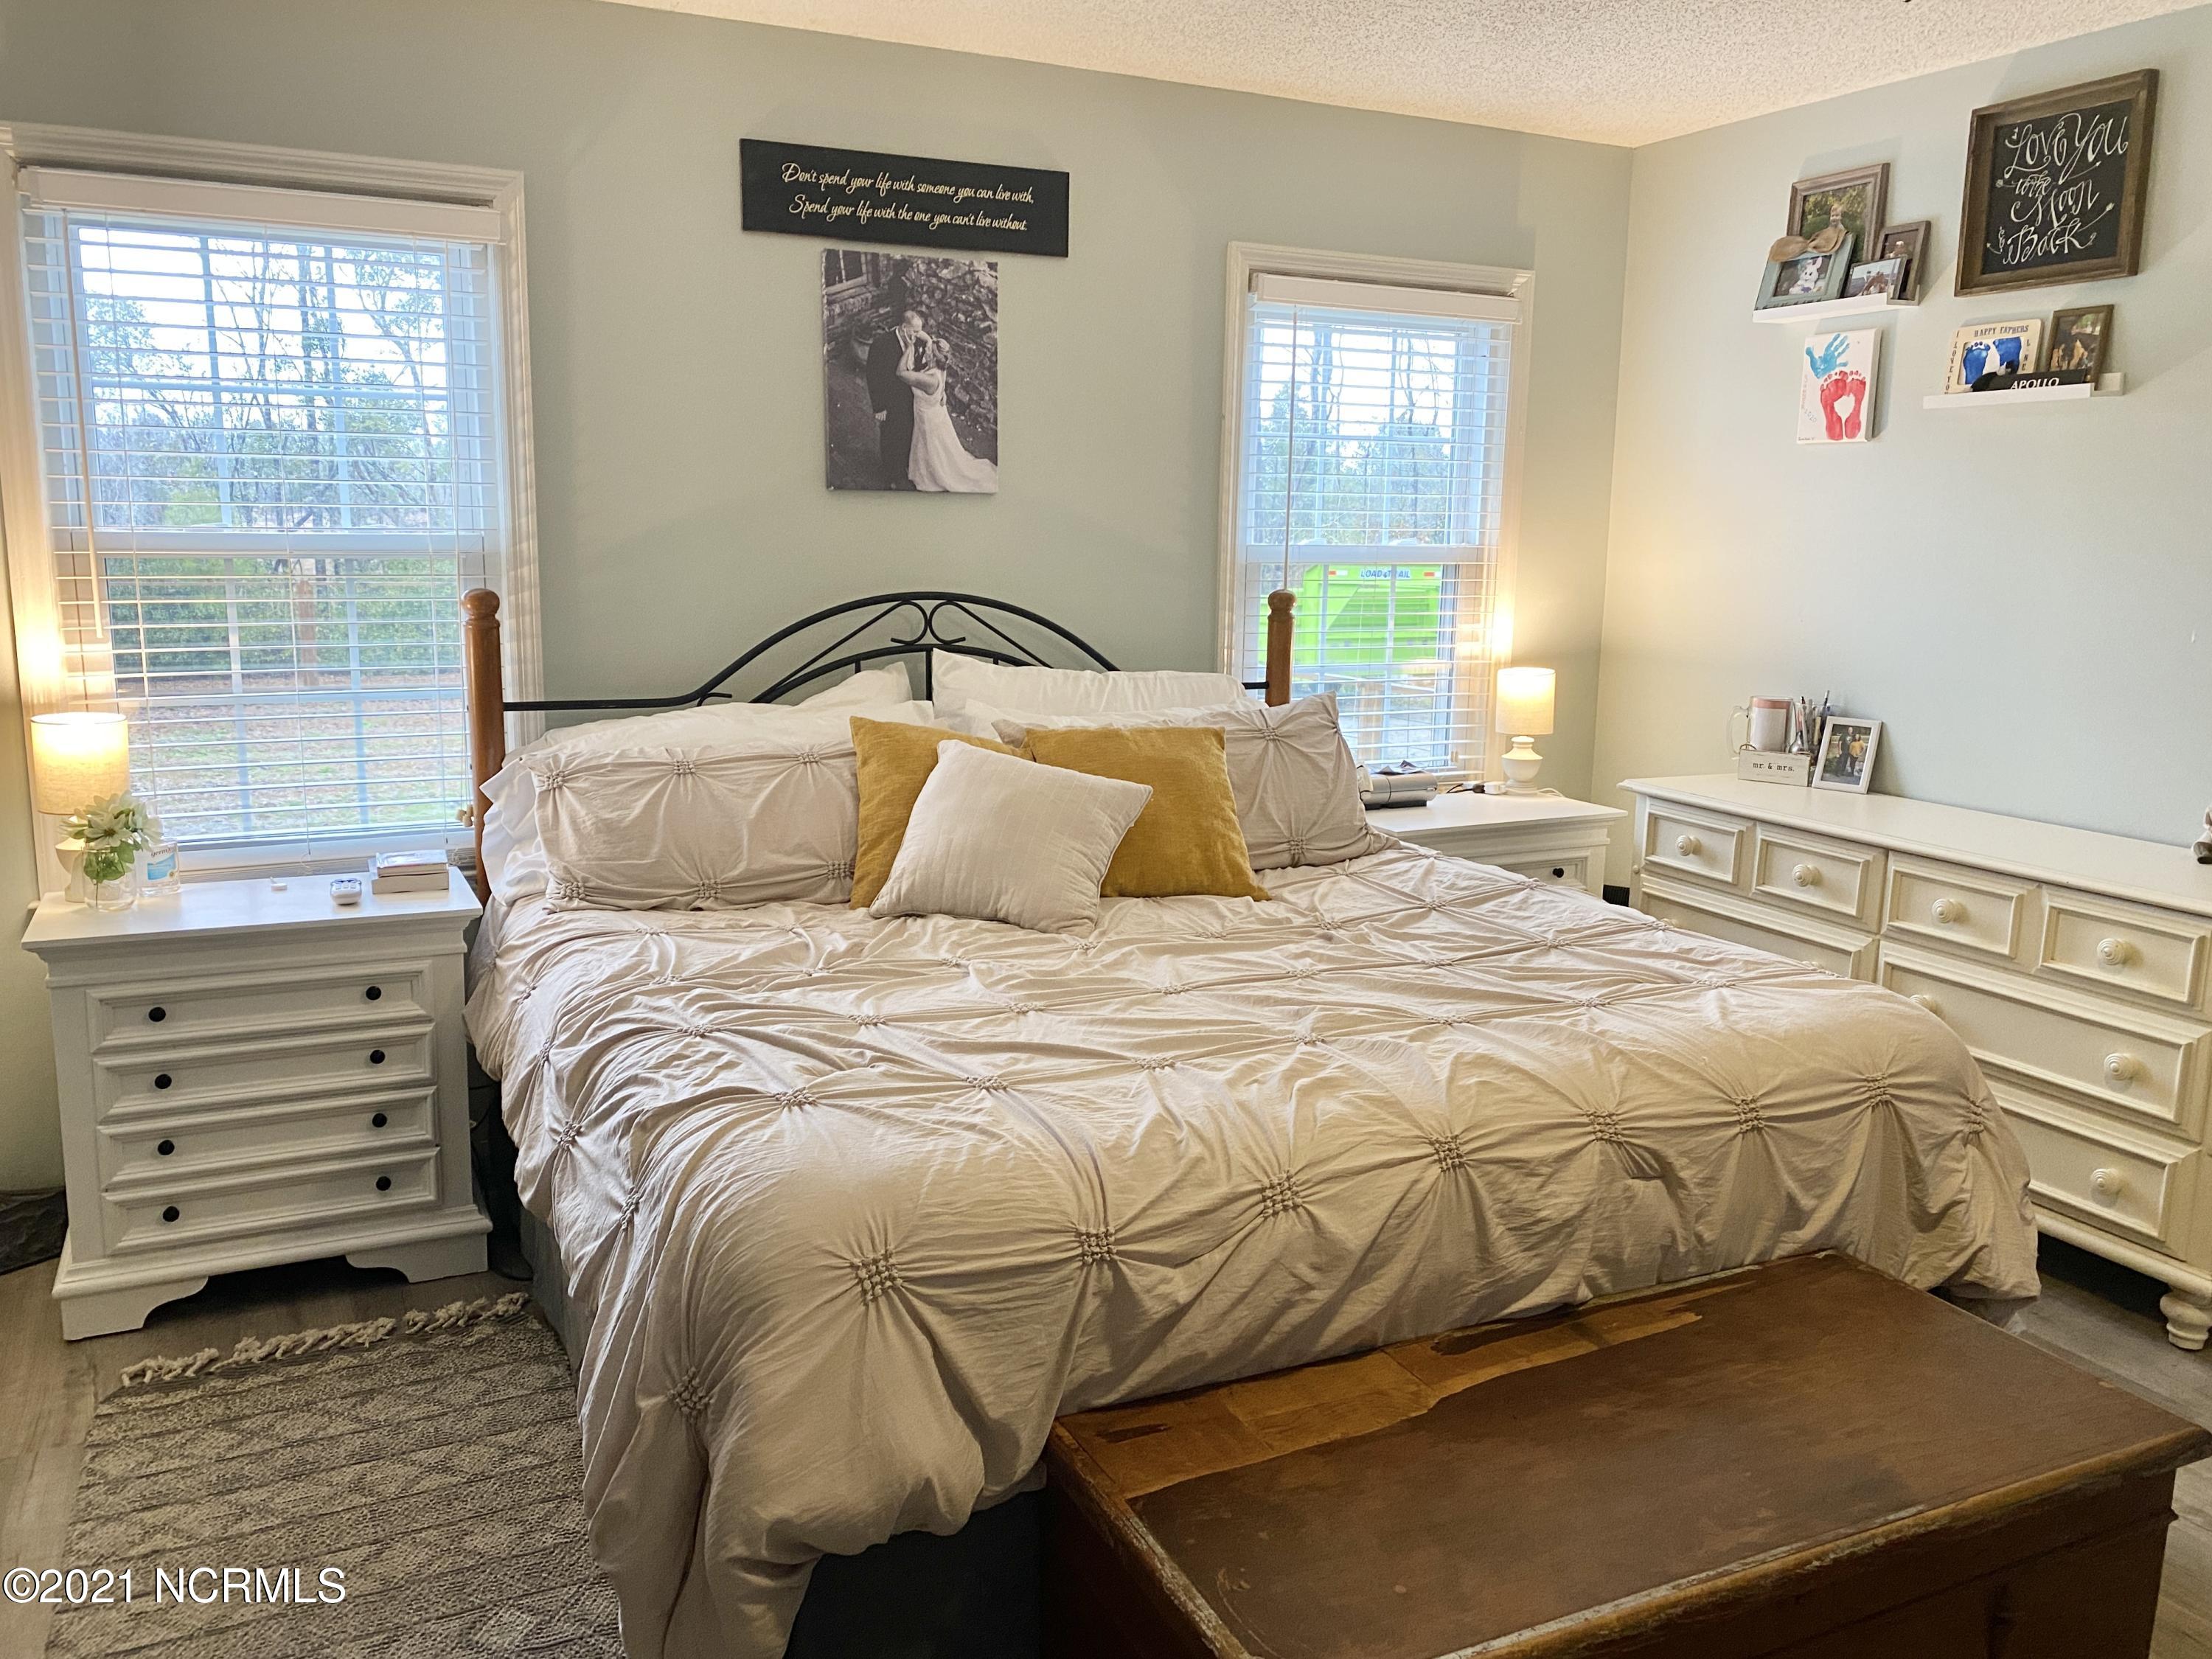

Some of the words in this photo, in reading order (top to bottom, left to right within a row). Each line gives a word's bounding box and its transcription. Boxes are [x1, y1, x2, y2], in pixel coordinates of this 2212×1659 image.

[782, 162, 817, 183] Don't
[818, 169, 851, 192] spend
[845, 175, 874, 195] your
[875, 171, 891, 197] life
[893, 175, 915, 192] with
[917, 182, 956, 195] someone
[953, 187, 975, 204] you
[976, 189, 994, 199] can
[995, 184, 1012, 201] live
[789, 193, 831, 220] Spend
[826, 204, 855, 223] your
[856, 200, 872, 225] life
[874, 203, 897, 219] with
[897, 204, 913, 220] the
[914, 211, 931, 222] one
[929, 214, 951, 230] you
[952, 212, 975, 226] can't
[976, 210, 991, 228] live
[992, 213, 1028, 231] without.
[1974, 327, 1997, 338] HAPPY
[2011, 377, 2060, 390] APOLLO
[1360, 569, 1383, 577] LOAD
[1388, 570, 1411, 578] TAIL
